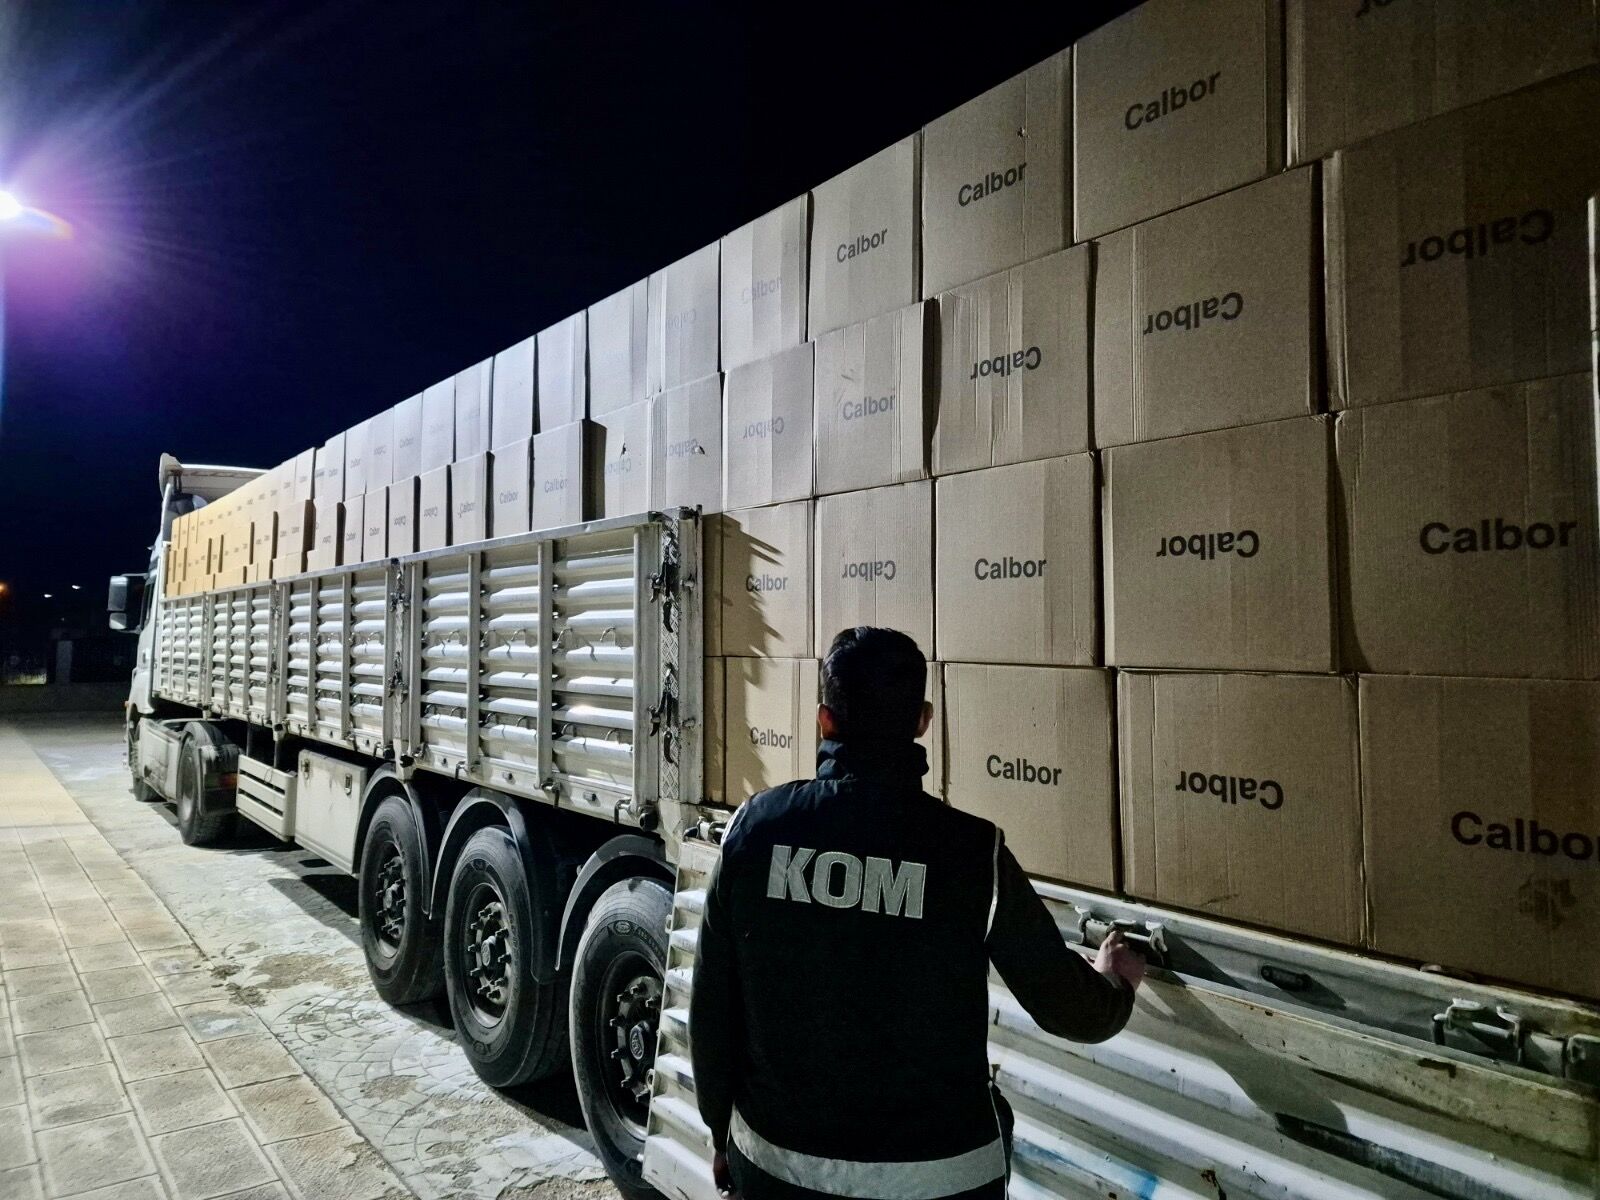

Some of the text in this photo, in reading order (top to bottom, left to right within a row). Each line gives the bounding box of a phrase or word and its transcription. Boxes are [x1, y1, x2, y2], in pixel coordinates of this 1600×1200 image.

[1125, 70, 1221, 131] Calbor
[957, 161, 1028, 207] Calbor
[837, 228, 888, 263] Calbor
[1400, 208, 1555, 268] Calbor
[1143, 291, 1245, 336] Calbor
[970, 345, 1042, 380] Calbor
[842, 395, 896, 421] Calbor
[743, 416, 785, 440] Calbor
[1156, 530, 1260, 561] Calbor
[1420, 517, 1577, 556] Calbor
[745, 574, 789, 592] Calbor
[842, 560, 896, 582] Calbor
[974, 556, 1047, 581] Calbor
[750, 726, 793, 750] Calbor
[987, 755, 1063, 786] Calbor
[1175, 769, 1284, 811] Calbor
[1451, 810, 1600, 862] Calbo
[766, 844, 928, 920] KOM
